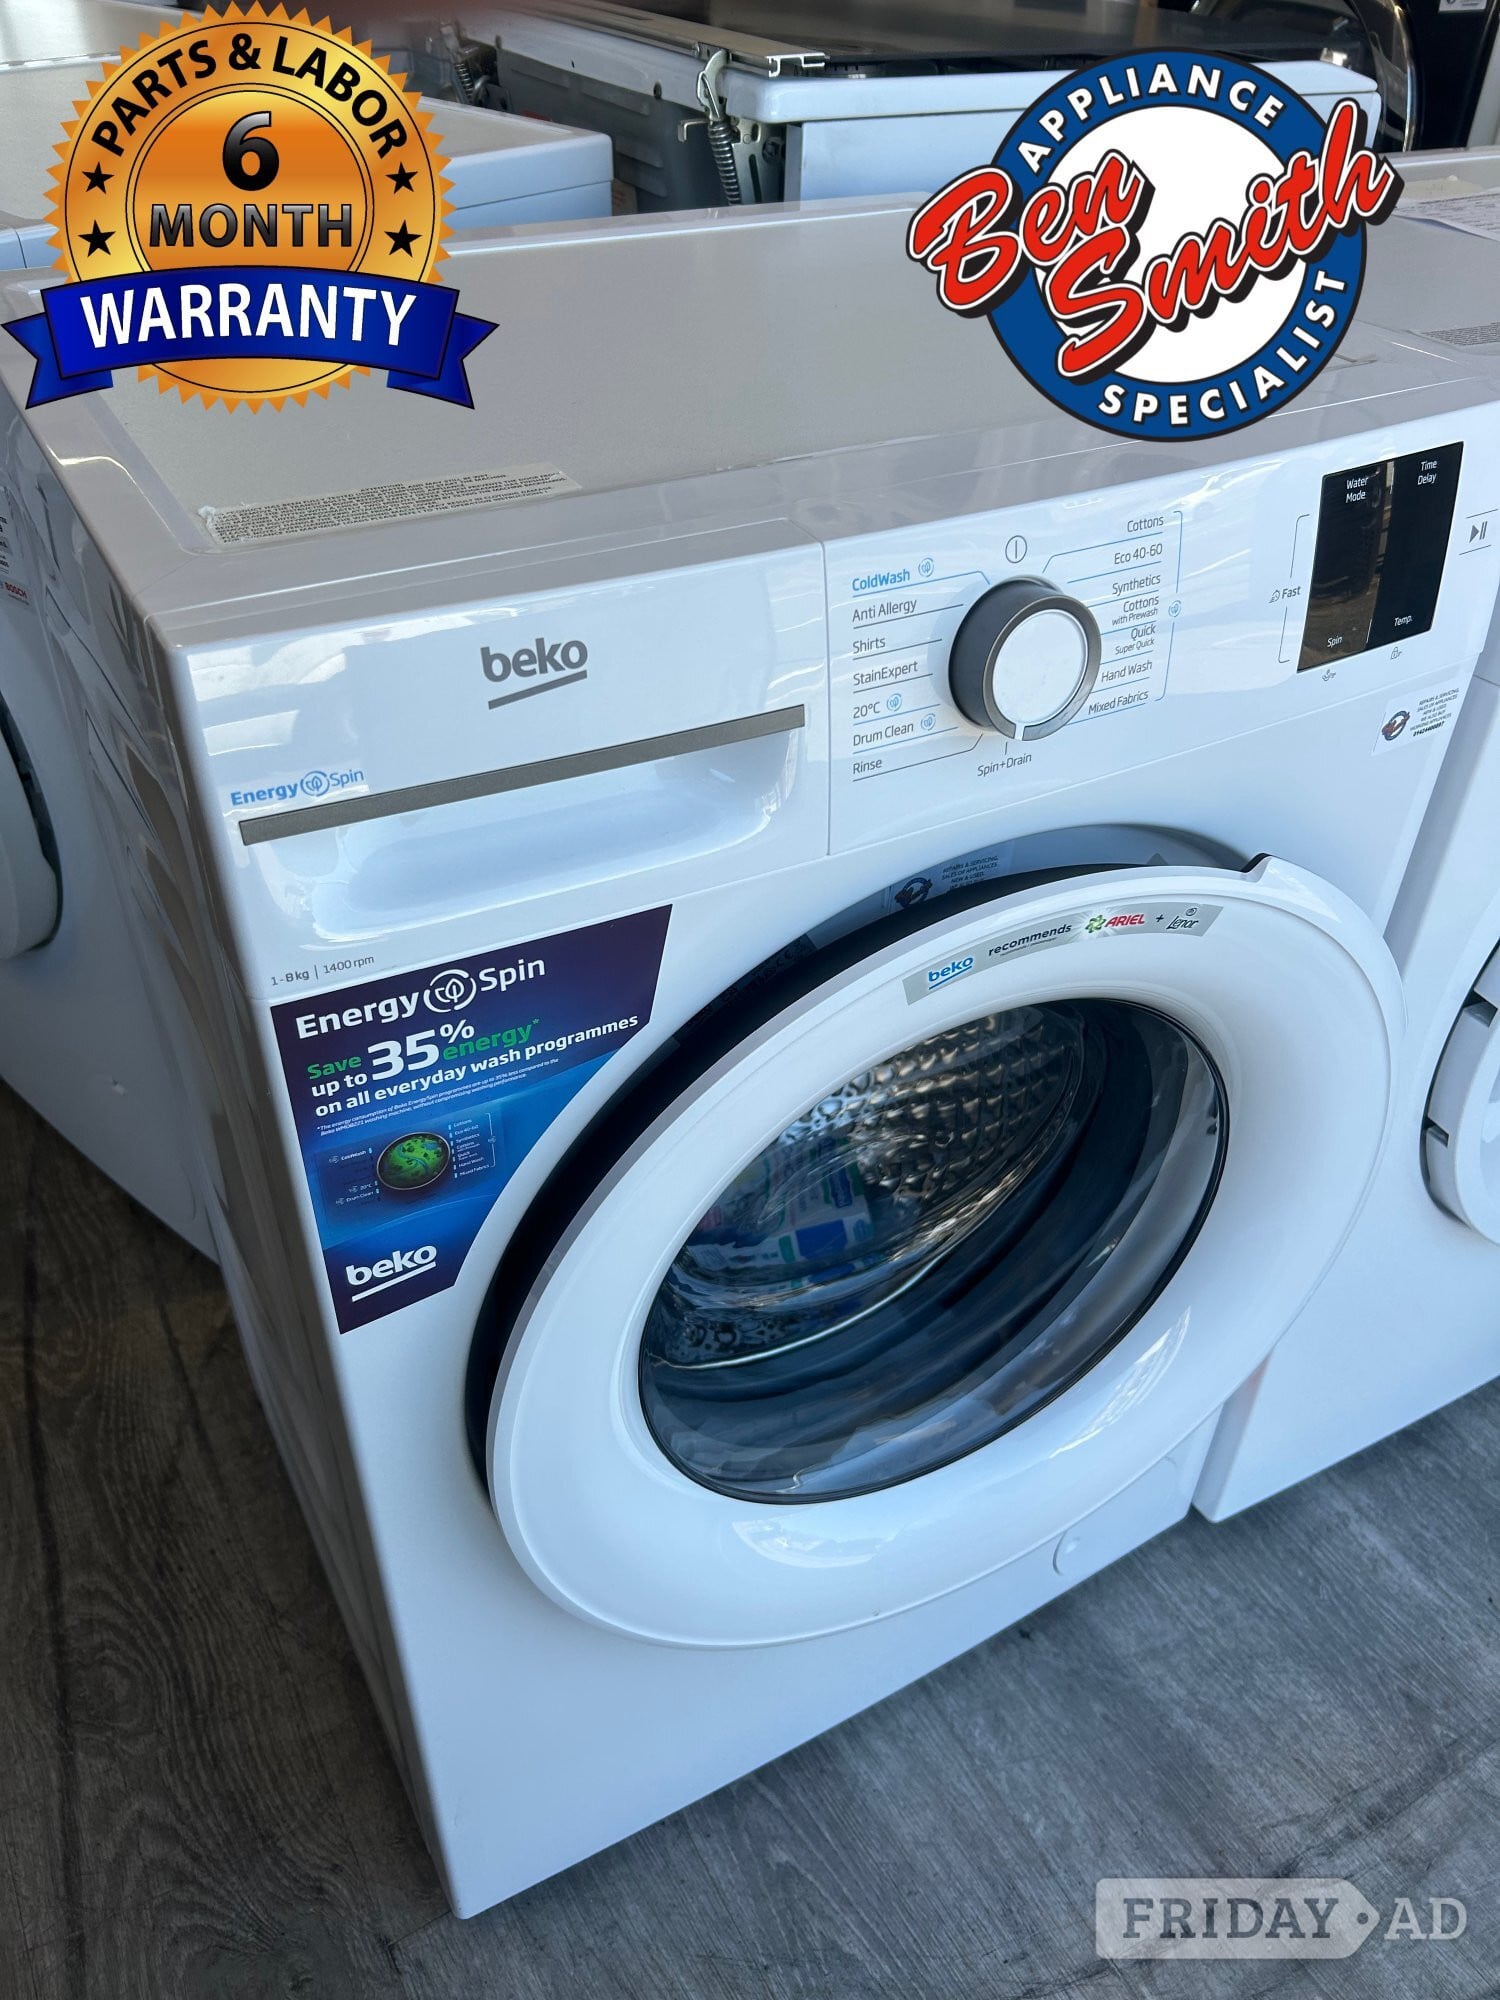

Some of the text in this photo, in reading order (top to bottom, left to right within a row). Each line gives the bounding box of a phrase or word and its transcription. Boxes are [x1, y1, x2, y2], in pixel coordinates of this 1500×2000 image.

[1420, 459, 1437, 472] Time
[1346, 476, 1369, 490] Water
[1417, 472, 1437, 486] Delay
[1345, 489, 1366, 504] Mode
[1127, 515, 1164, 533] Cottons
[1114, 543, 1163, 565] Eco 40-60
[852, 568, 911, 591] ColdWash
[1111, 574, 1161, 596] Synthetics
[1282, 585, 1301, 599] Fast
[852, 599, 917, 623] Anti Allergy
[1123, 596, 1159, 613] Cottons
[1112, 607, 1158, 626] with Prewash
[1130, 624, 1156, 641] Quick
[1327, 635, 1343, 648] Spin
[852, 637, 886, 654] Shirts
[1115, 637, 1155, 657] Super Quick
[480, 637, 588, 682] beko
[853, 660, 918, 686] StainExpert
[1101, 660, 1153, 683] Hand Wash
[853, 701, 881, 719] 20°C
[1088, 689, 1149, 715] Mixed Fabrics
[853, 722, 914, 747] Drum Clean
[853, 757, 882, 774] Rinse
[977, 753, 1032, 777] Spin+Drain
[230, 768, 364, 806] Energy Spin
[928, 956, 973, 983] beko
[988, 924, 1072, 957] recommends
[1104, 914, 1145, 928] ARIEL
[1166, 915, 1199, 929] Lenor
[324, 960, 351, 974] 1400
[353, 956, 375, 967] rpm
[296, 959, 546, 1039] Energy Spin
[367, 1019, 475, 1080] 35%
[307, 1056, 362, 1080] Save
[315, 1015, 639, 1117] on all everyday wash programmes
[311, 1073, 368, 1097] up to
[345, 1245, 437, 1286] beko
